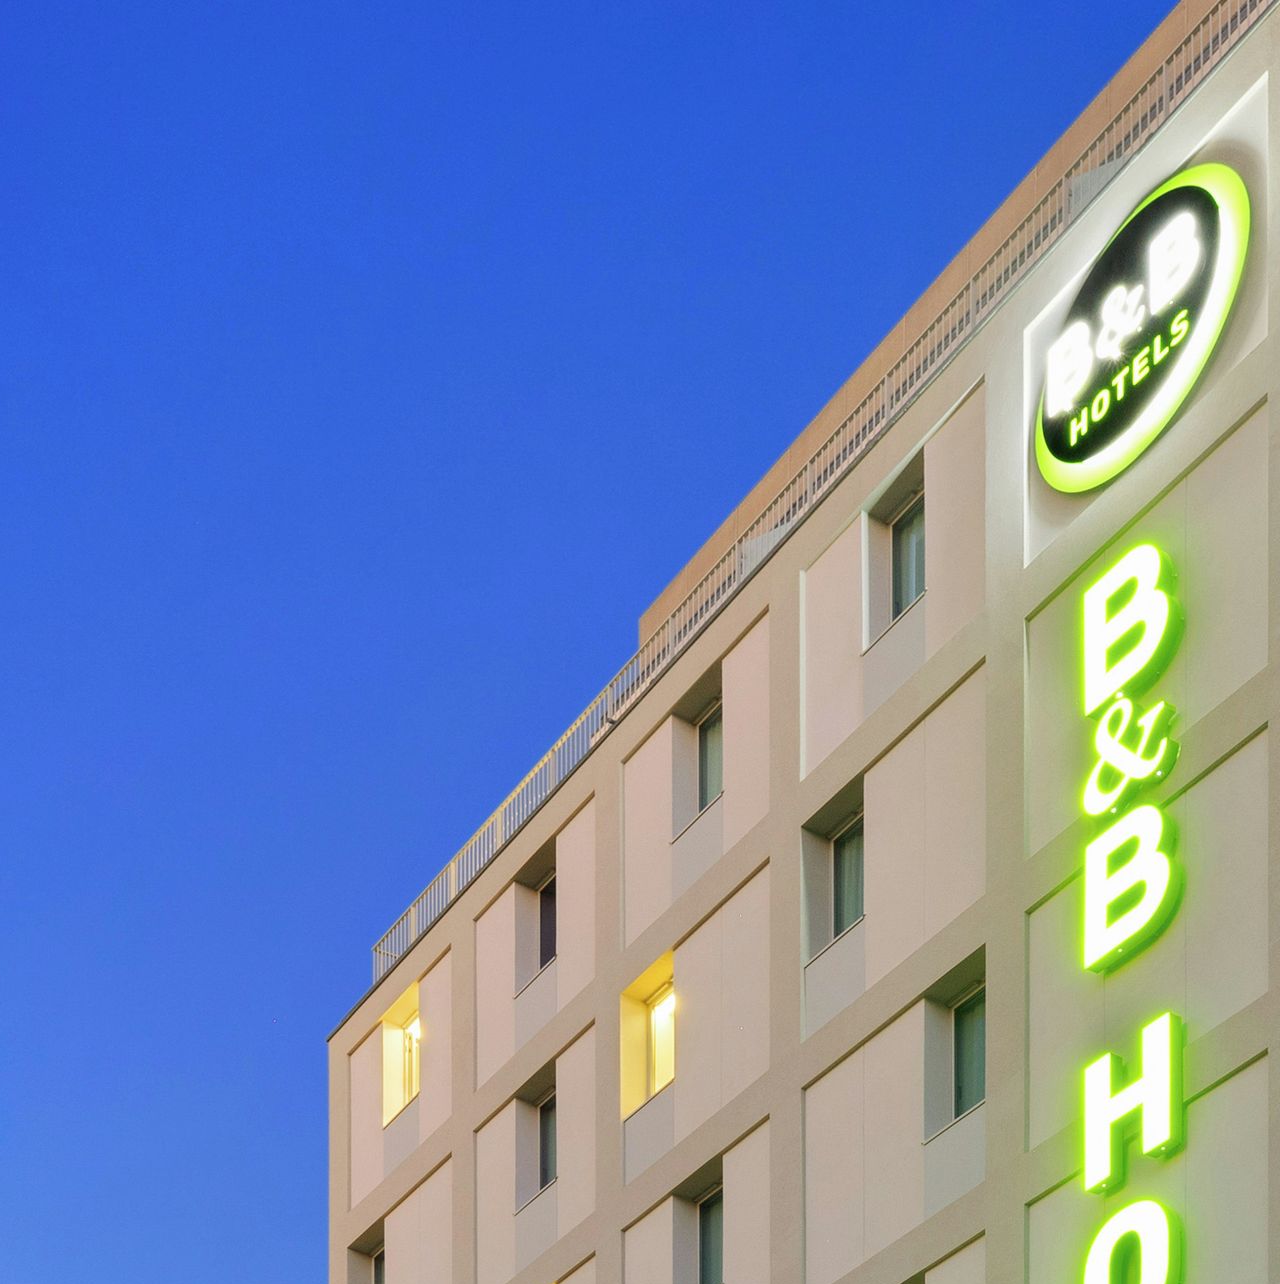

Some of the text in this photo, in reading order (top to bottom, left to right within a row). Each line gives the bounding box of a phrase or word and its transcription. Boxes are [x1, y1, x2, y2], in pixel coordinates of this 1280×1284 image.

[1046, 210, 1201, 418] B&B
[1068, 308, 1191, 448] HOTELS
[1082, 543, 1174, 971] B&B
